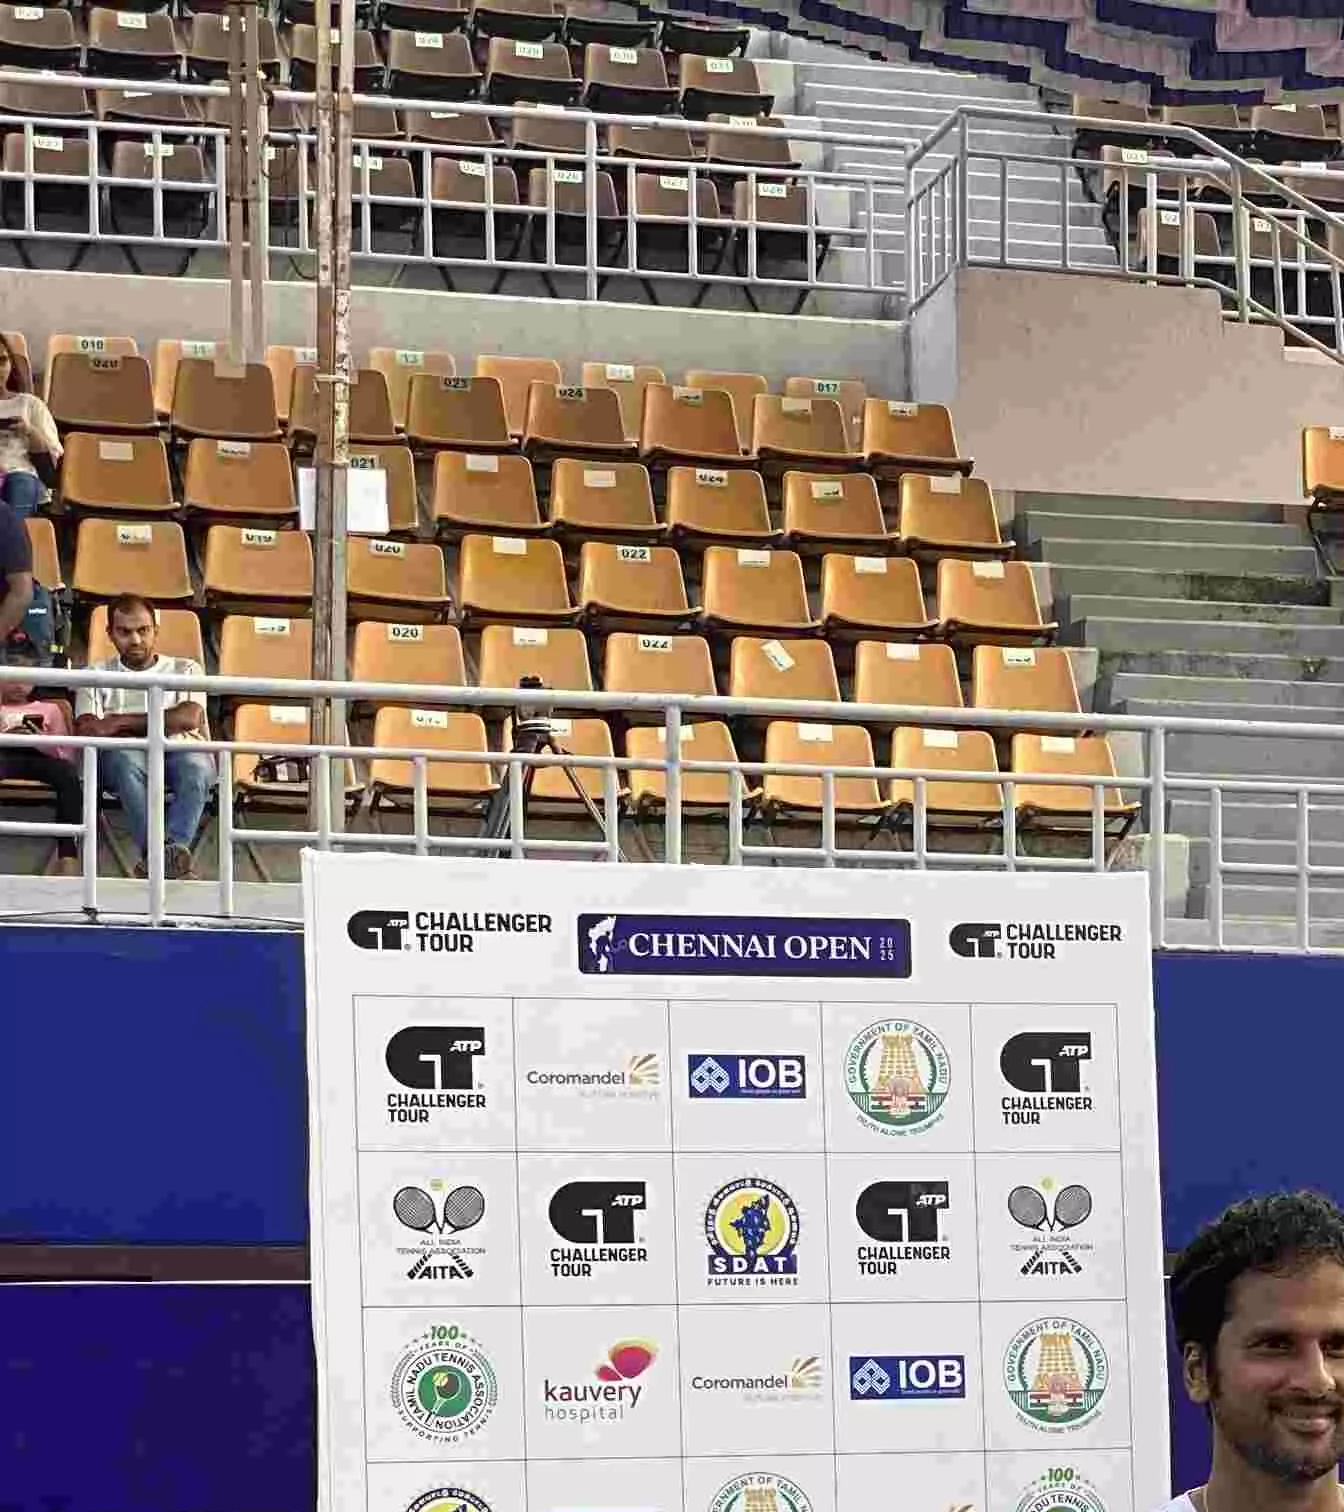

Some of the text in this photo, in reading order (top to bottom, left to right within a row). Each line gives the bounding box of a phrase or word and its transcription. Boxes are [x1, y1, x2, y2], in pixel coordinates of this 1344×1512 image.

[81, 339, 104, 351] 010
[351, 457, 376, 469] 021
[621, 548, 647, 560] 022
[393, 627, 418, 639] 020
[415, 911, 553, 933] CHALLENGER
[1006, 924, 1122, 942] CHALLENGER
[415, 933, 474, 953] TOUR
[628, 933, 871, 961] CHENNAI OPEN
[1007, 942, 1055, 959] TOUR
[450, 1040, 482, 1052] ATP
[848, 1023, 892, 1084] GOVERNMENT
[1059, 1045, 1088, 1057] ATP
[527, 1070, 625, 1085] Coromandel
[739, 1058, 803, 1089] IOB
[387, 1093, 486, 1108] CHALLENGER
[1001, 1097, 1092, 1110] CHALLENGER
[388, 1109, 429, 1123] TOUR
[1002, 1112, 1040, 1125] TOUR
[611, 1195, 643, 1207] ATP
[916, 1195, 946, 1207] ATP
[550, 1248, 648, 1262] CHALLENGER
[857, 1246, 951, 1261] CHALLENGER
[418, 1265, 464, 1280] AITA
[551, 1264, 592, 1277] TOUR
[713, 1256, 788, 1274] SDAT
[858, 1261, 897, 1276] TOUR
[1032, 1261, 1071, 1275] AITA
[708, 1277, 798, 1287] FUTURE IS HERE
[430, 1325, 459, 1340] 100
[1007, 1322, 1049, 1382] GOVERNMENT
[899, 1359, 961, 1388] IOB
[692, 1374, 788, 1390] Coromandel
[406, 1353, 484, 1430] TAMIL NADU TENNIS ASSOCIATION
[544, 1380, 642, 1408] kauvery
[545, 1405, 624, 1424] hospital
[1047, 1468, 1074, 1483] 100
